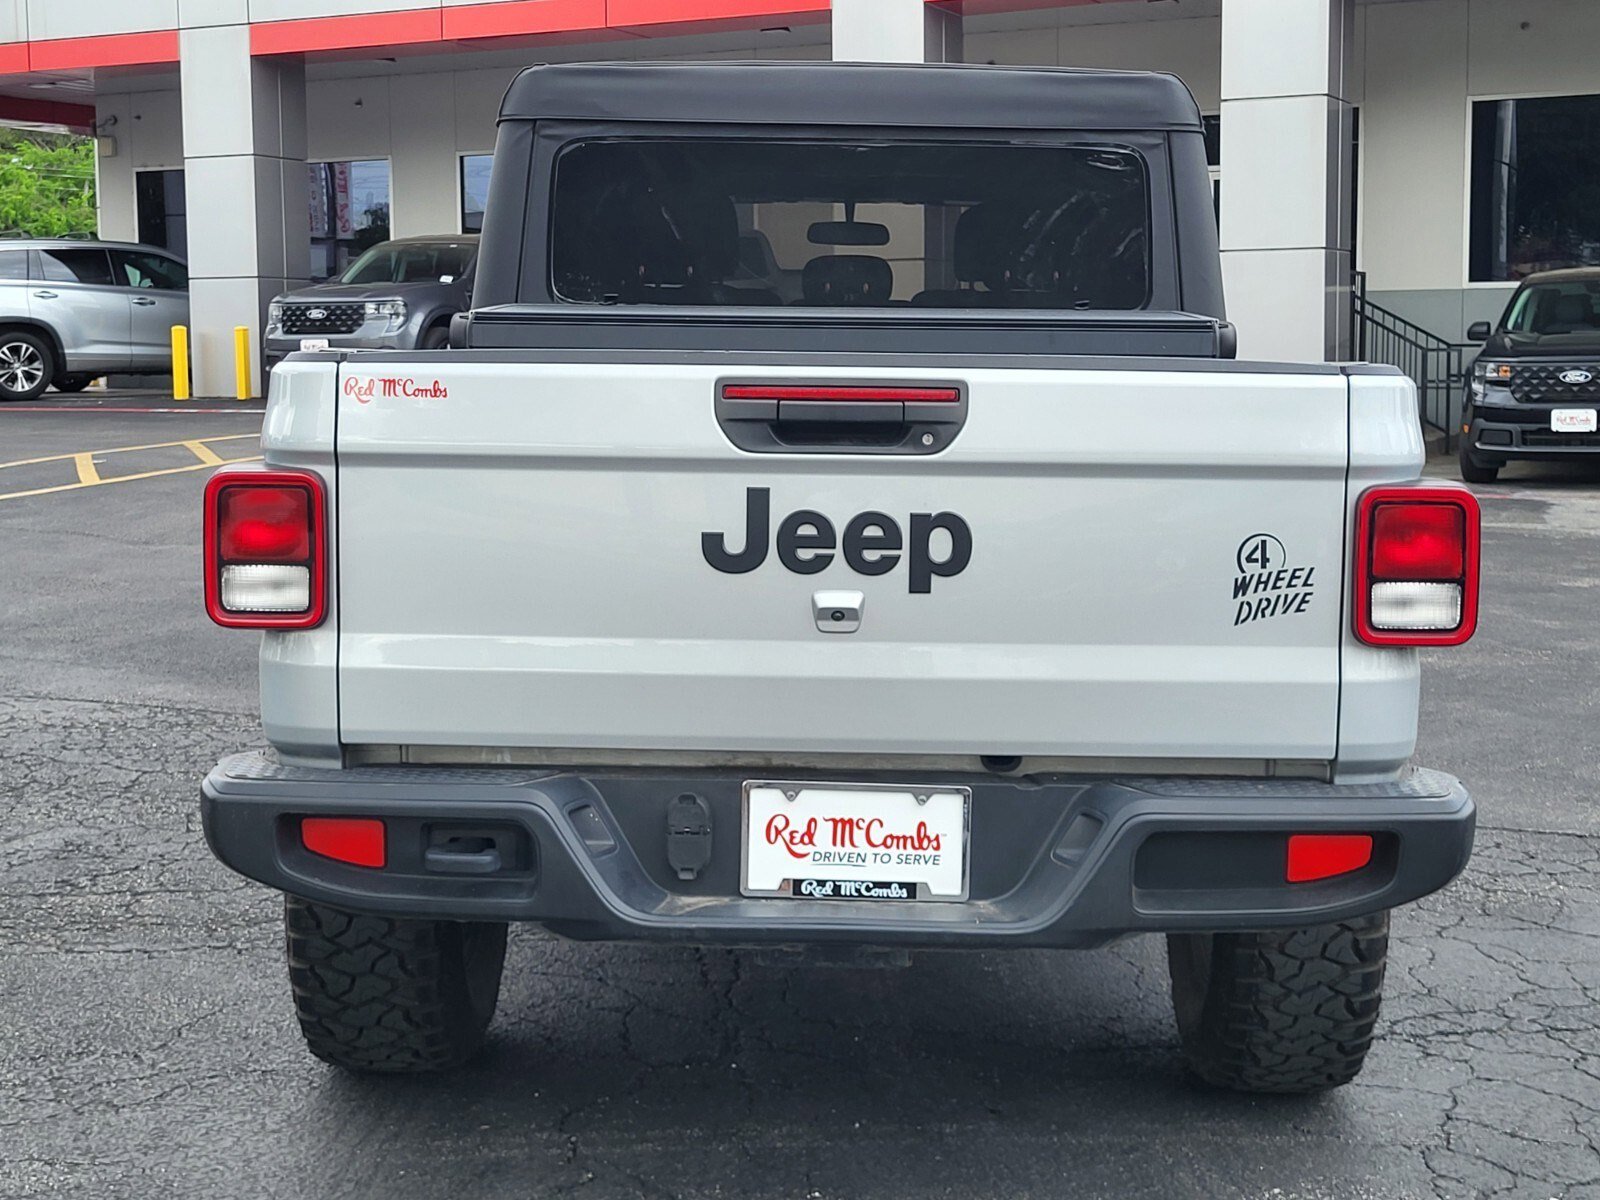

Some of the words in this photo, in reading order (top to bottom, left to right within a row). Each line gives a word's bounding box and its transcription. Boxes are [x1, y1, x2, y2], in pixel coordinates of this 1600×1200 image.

[344, 377, 375, 404] Red
[378, 378, 448, 398] McCombs
[701, 487, 973, 594] Jeep
[1245, 539, 1270, 569] 4
[1233, 567, 1315, 600] WHEEL
[1234, 592, 1314, 626] DRIVE
[765, 813, 817, 859] Red
[823, 816, 941, 851] McCombs
[812, 851, 867, 863] DRIVEN
[872, 852, 892, 864] TO
[896, 853, 942, 865] SERVE
[801, 879, 834, 897] Red
[835, 881, 908, 898] McCombs
